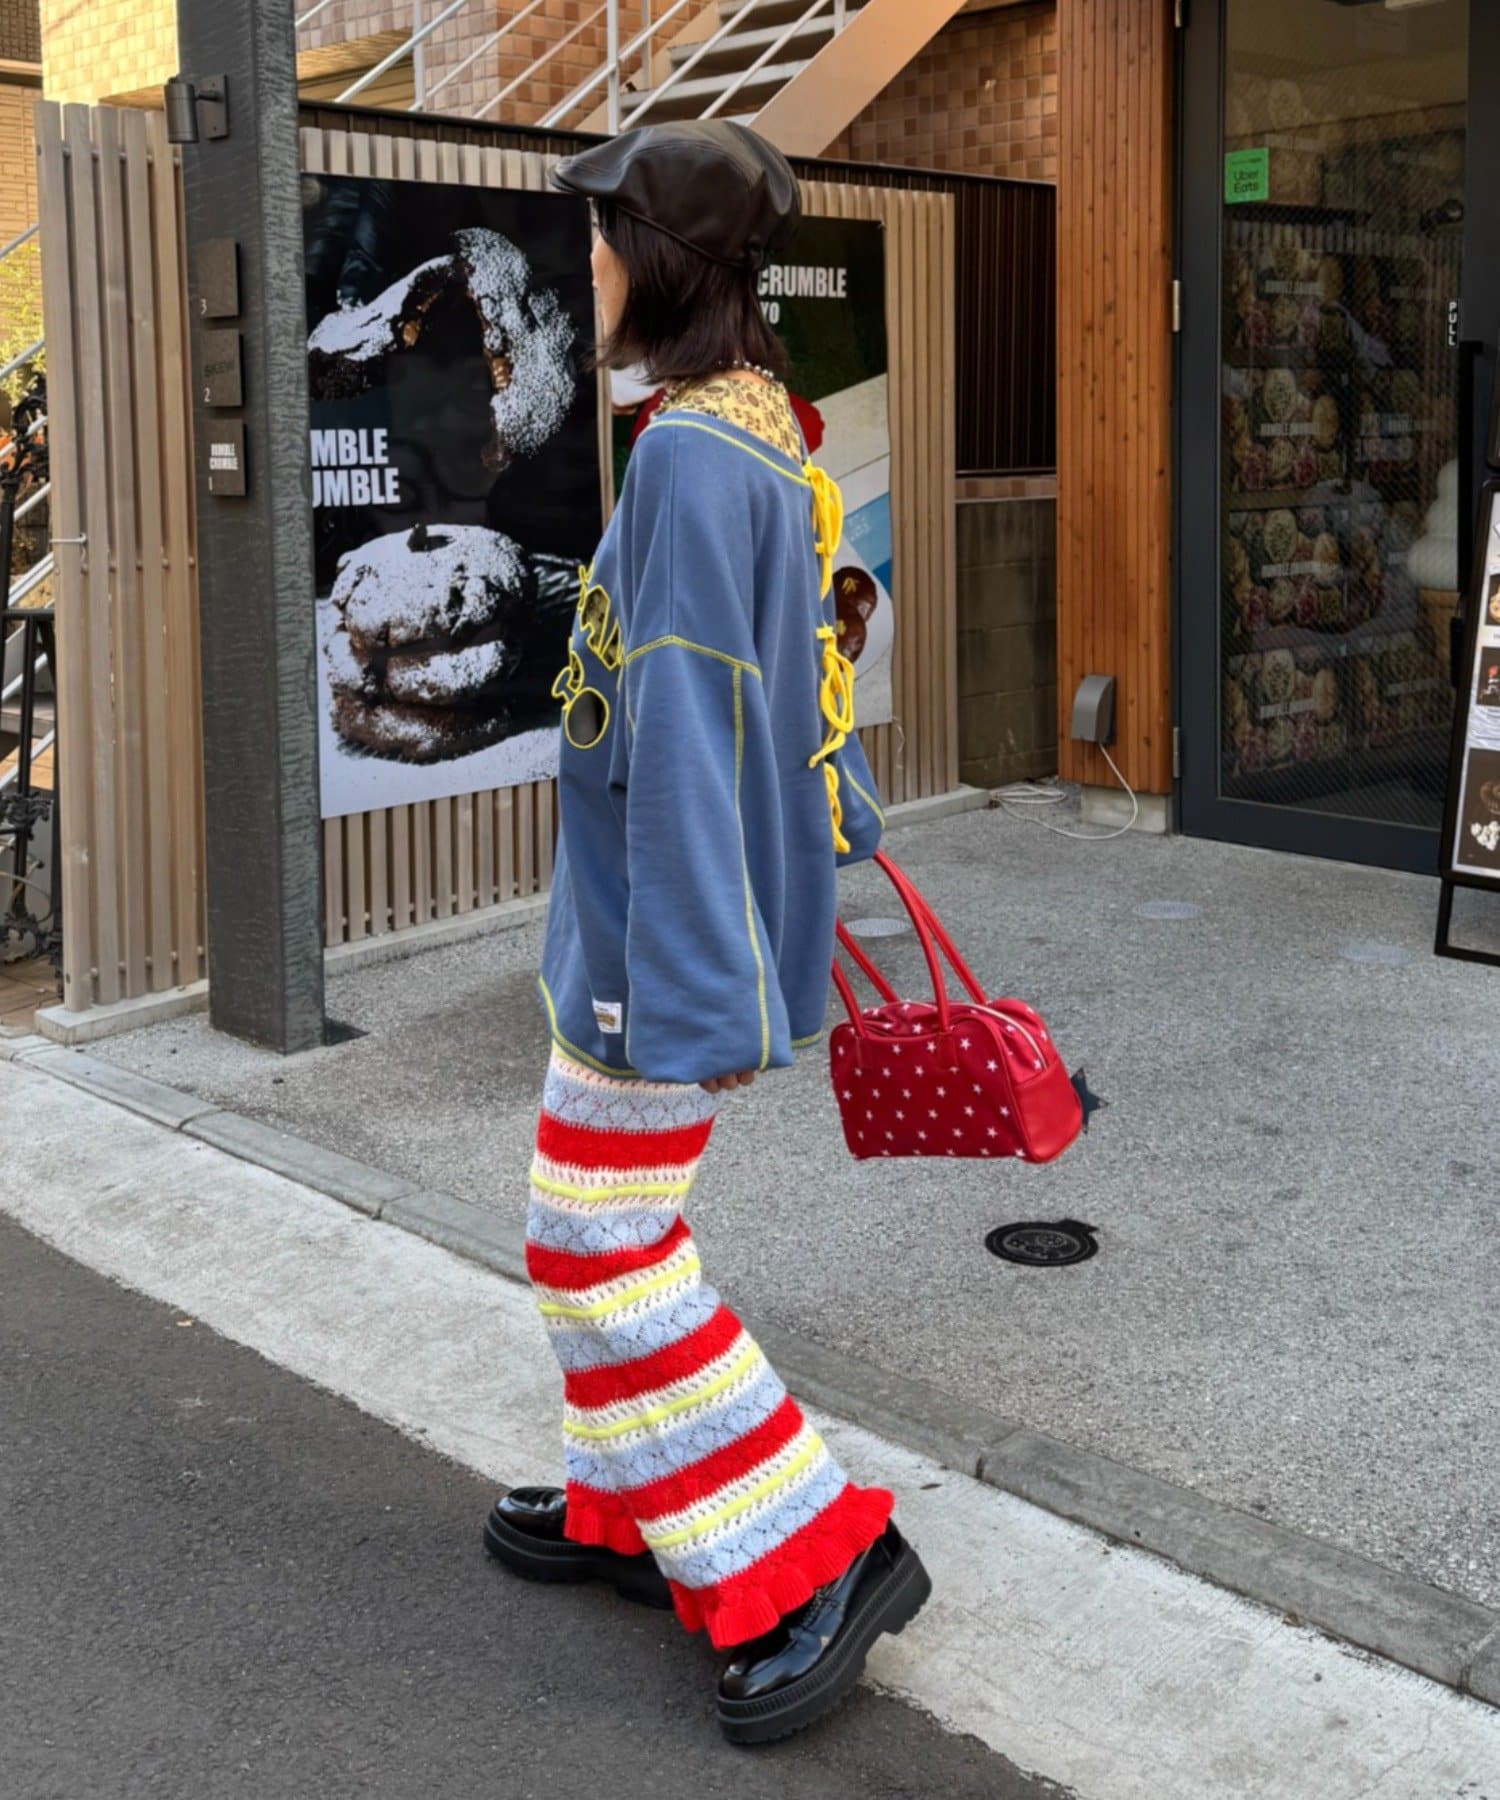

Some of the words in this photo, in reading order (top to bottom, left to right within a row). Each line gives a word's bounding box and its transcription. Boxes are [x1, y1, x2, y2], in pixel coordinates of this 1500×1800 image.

[1233, 170, 1259, 181] Uber
[1234, 182, 1259, 194] Eats
[757, 265, 847, 298] CRUMBLE
[200, 298, 207, 315] 3
[1448, 301, 1458, 346] PULL
[204, 387, 211, 402] 2
[310, 428, 389, 467] MBLE
